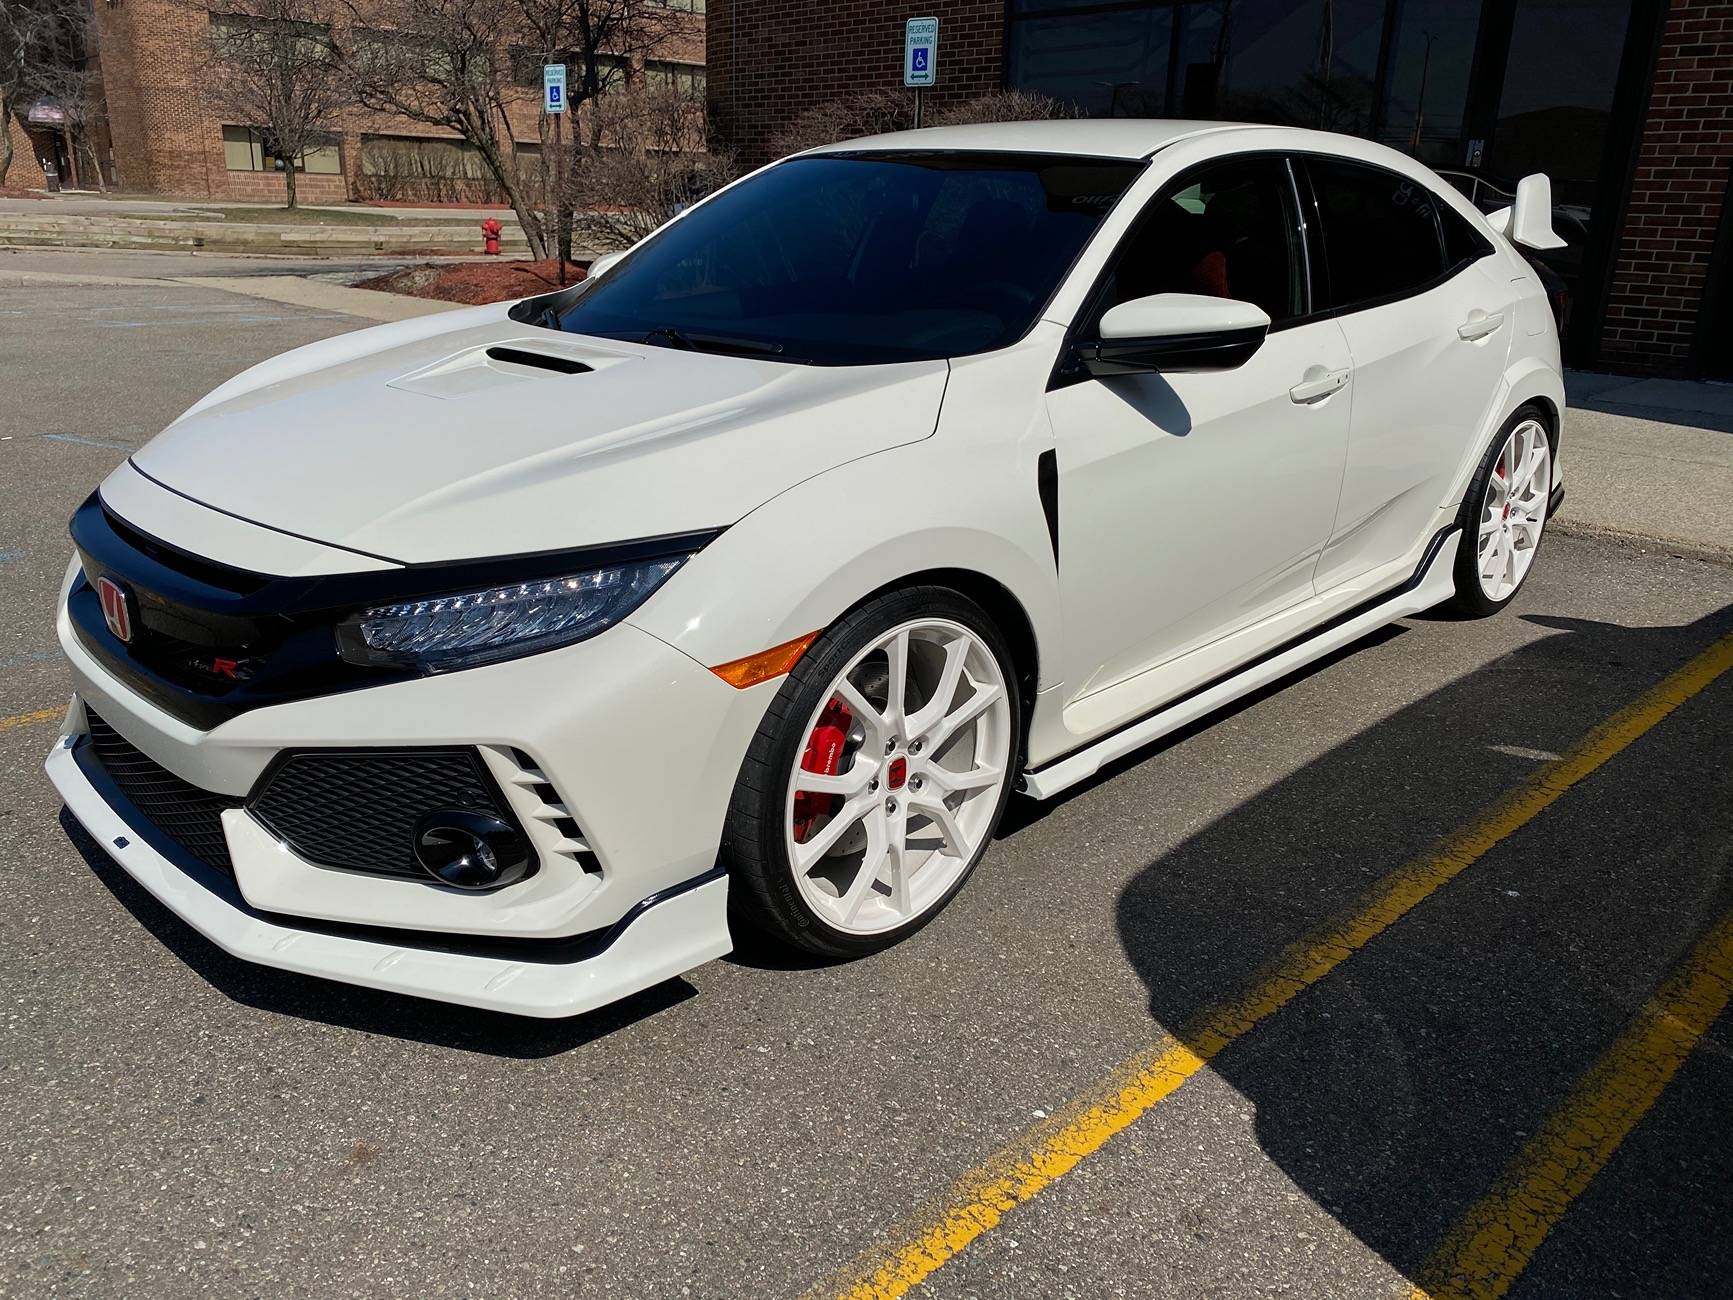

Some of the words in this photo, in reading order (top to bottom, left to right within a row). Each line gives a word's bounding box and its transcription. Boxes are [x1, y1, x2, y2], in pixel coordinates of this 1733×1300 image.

[908, 24, 935, 34] RESERVED
[909, 36, 933, 45] PARKING
[823, 742, 836, 773] brembo
